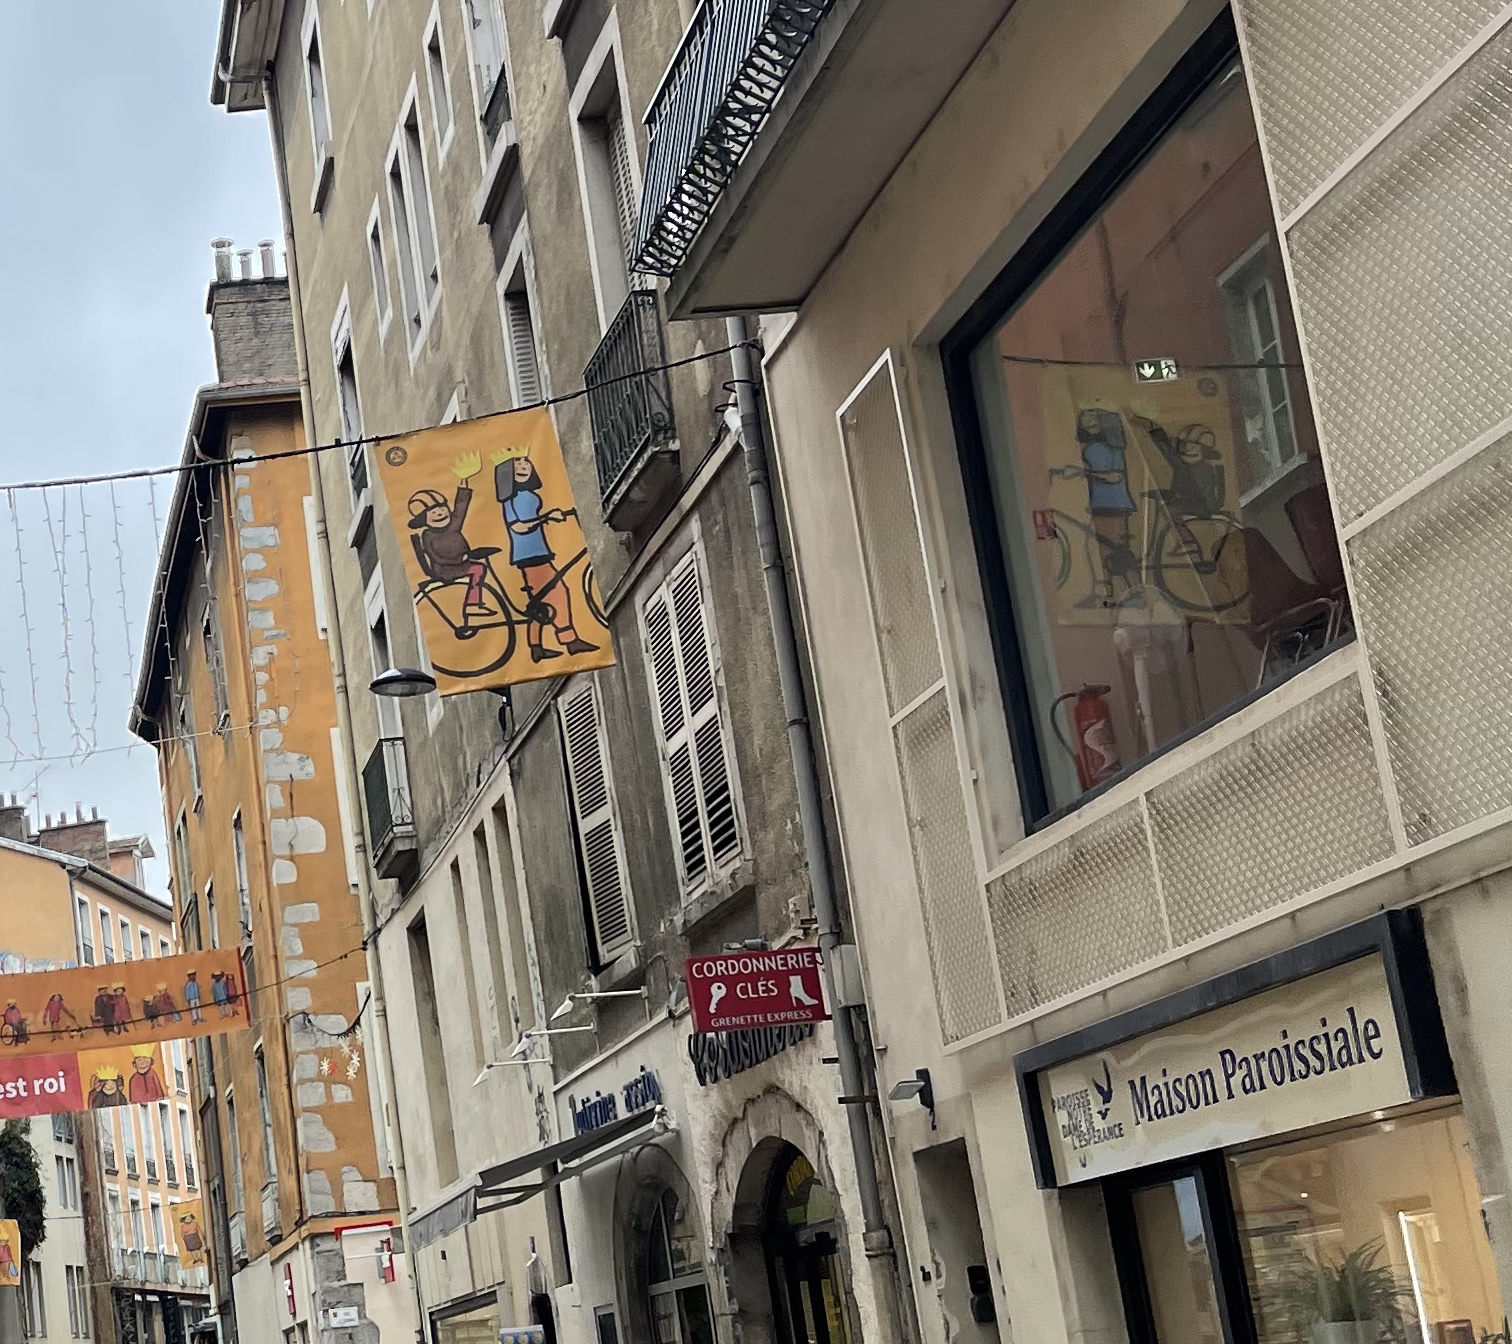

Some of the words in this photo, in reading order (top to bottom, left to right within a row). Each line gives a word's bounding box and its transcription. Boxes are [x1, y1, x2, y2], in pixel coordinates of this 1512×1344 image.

[692, 951, 815, 979] CORDONNERIE
[736, 976, 778, 999] CLÉS
[710, 1013, 766, 1028] GRENETTE
[766, 1008, 813, 1023] EXPRESS
[1128, 1068, 1219, 1126] Maison
[1218, 1006, 1384, 1101] Paroissiale
[33, 1070, 66, 1096] roi
